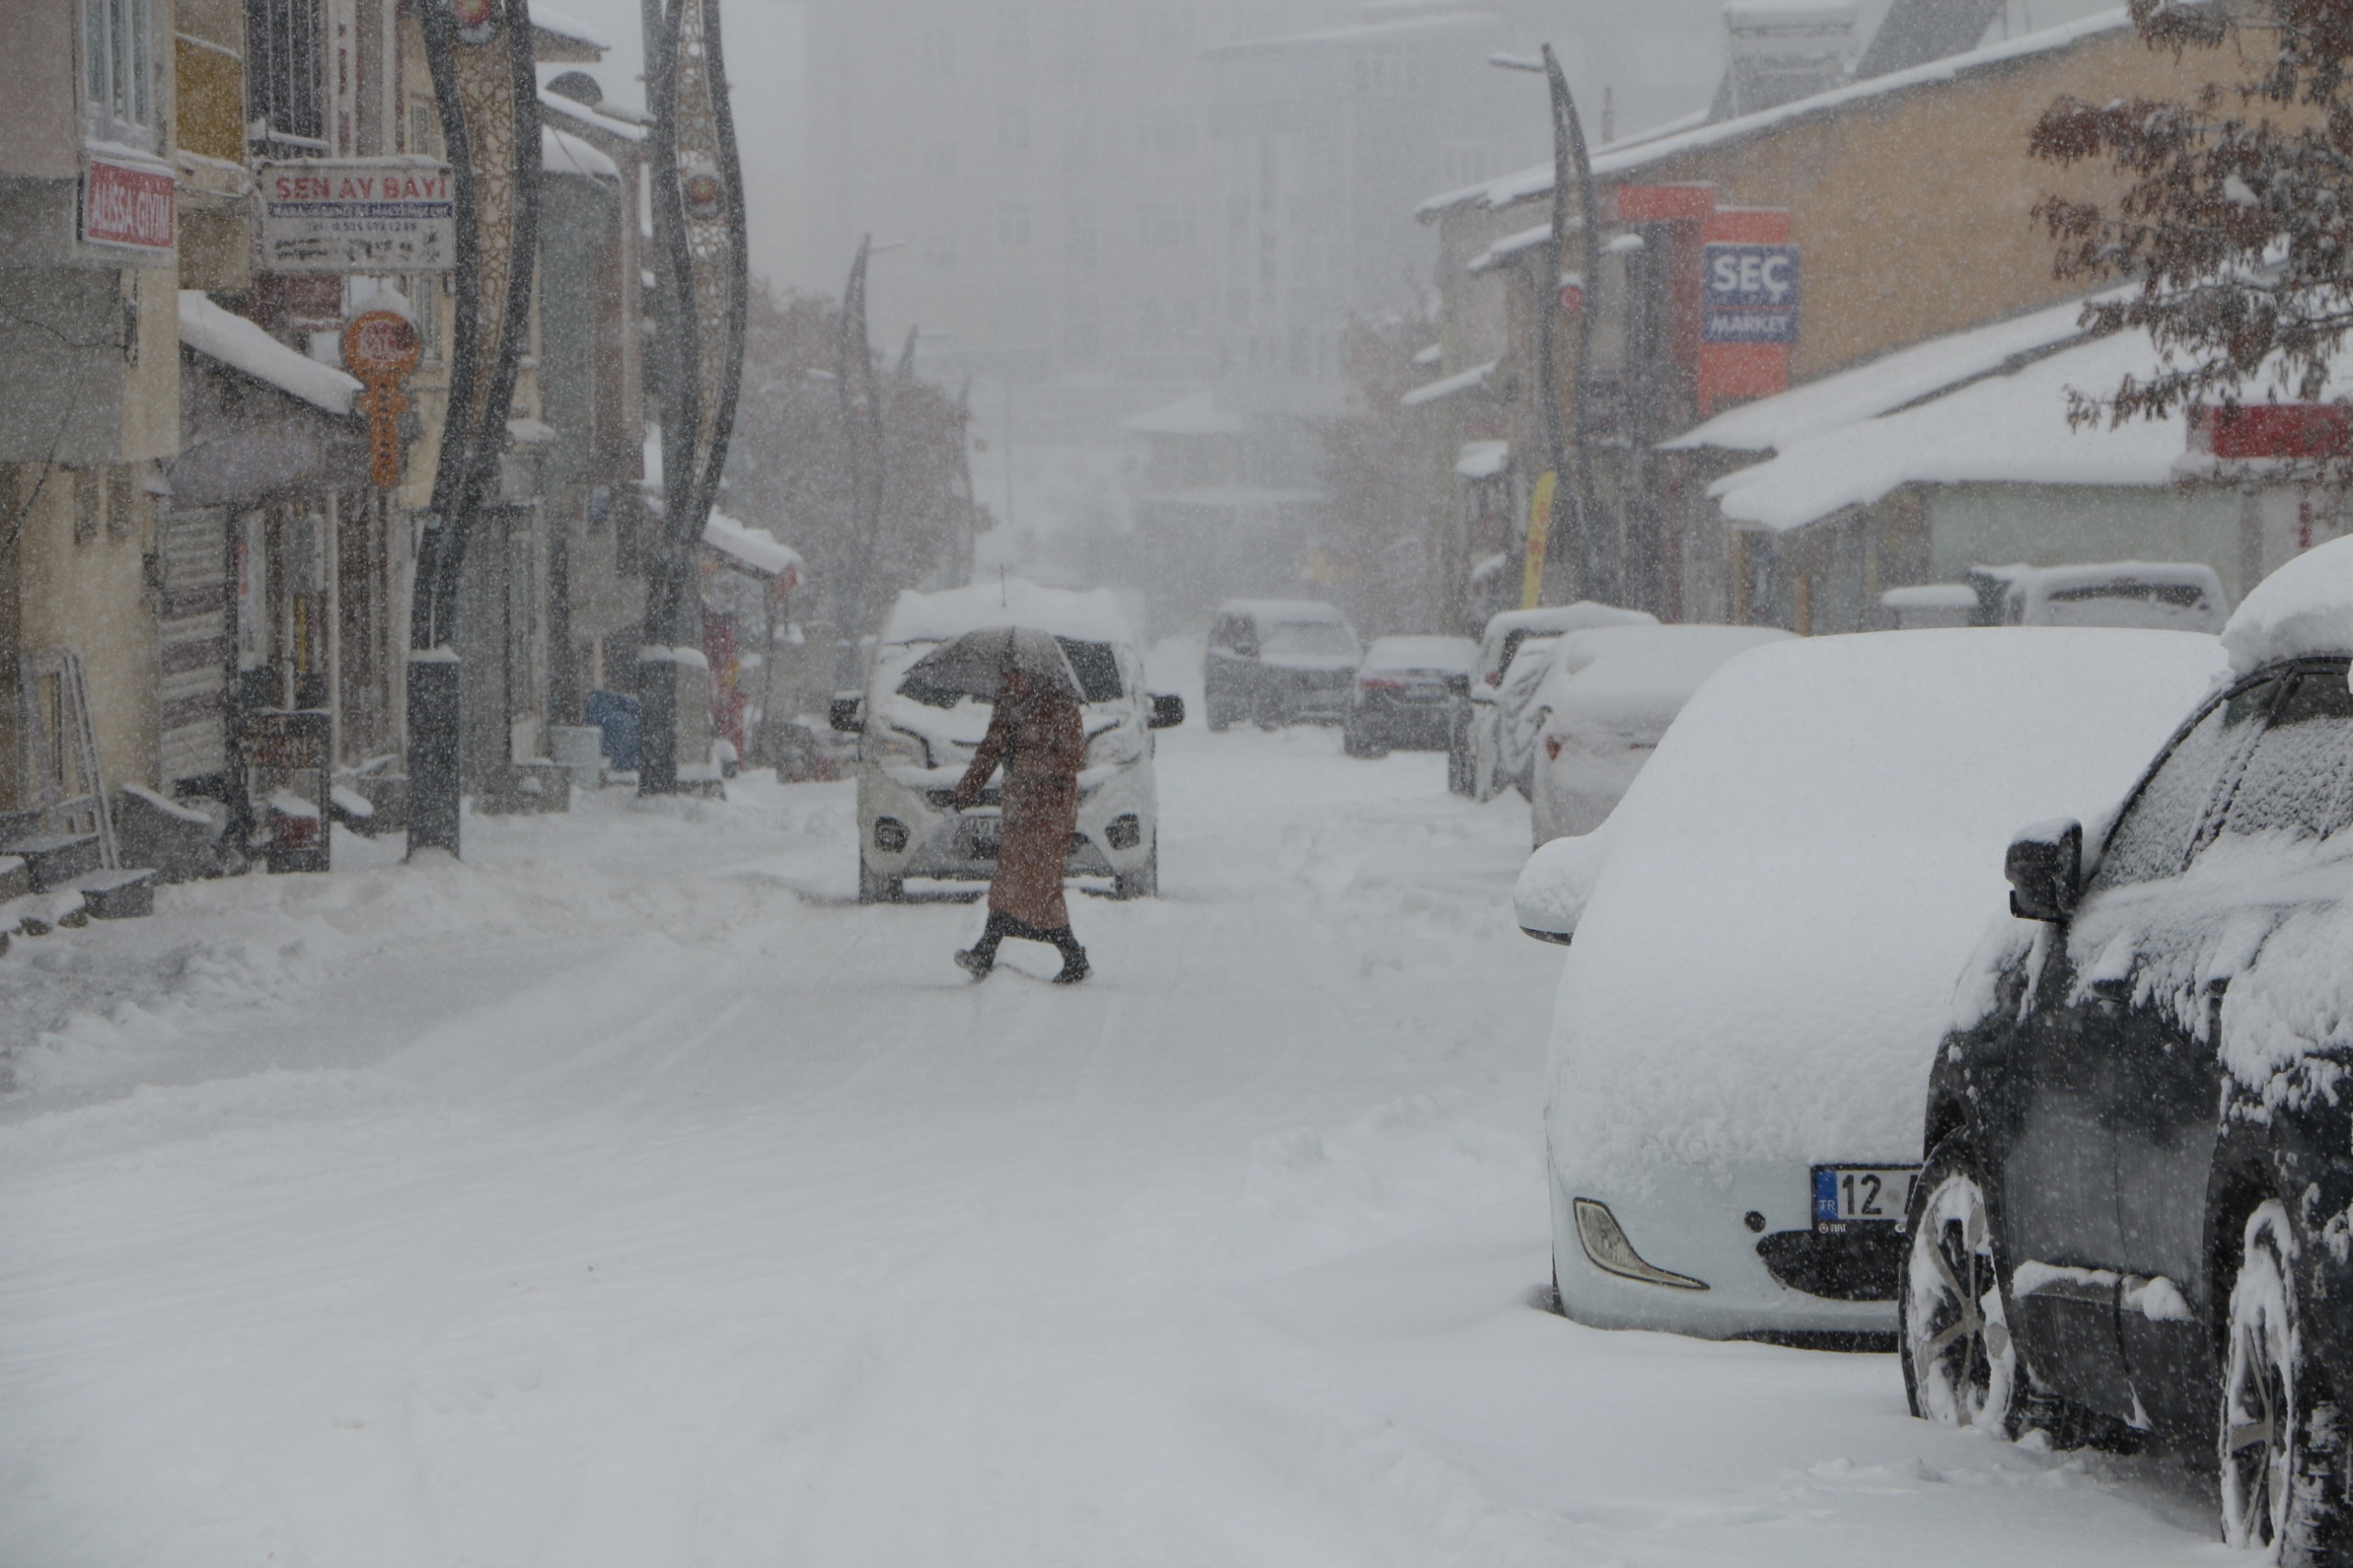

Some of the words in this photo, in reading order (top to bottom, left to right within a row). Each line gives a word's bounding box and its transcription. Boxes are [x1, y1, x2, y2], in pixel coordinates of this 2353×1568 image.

[338, 176, 375, 199] AV
[1713, 255, 1790, 303] SEÇ
[1711, 314, 1790, 335] MARKET
[1819, 1199, 1836, 1210] TR
[1842, 1175, 1882, 1215] 12
[1830, 1223, 1847, 1233] FIAT
